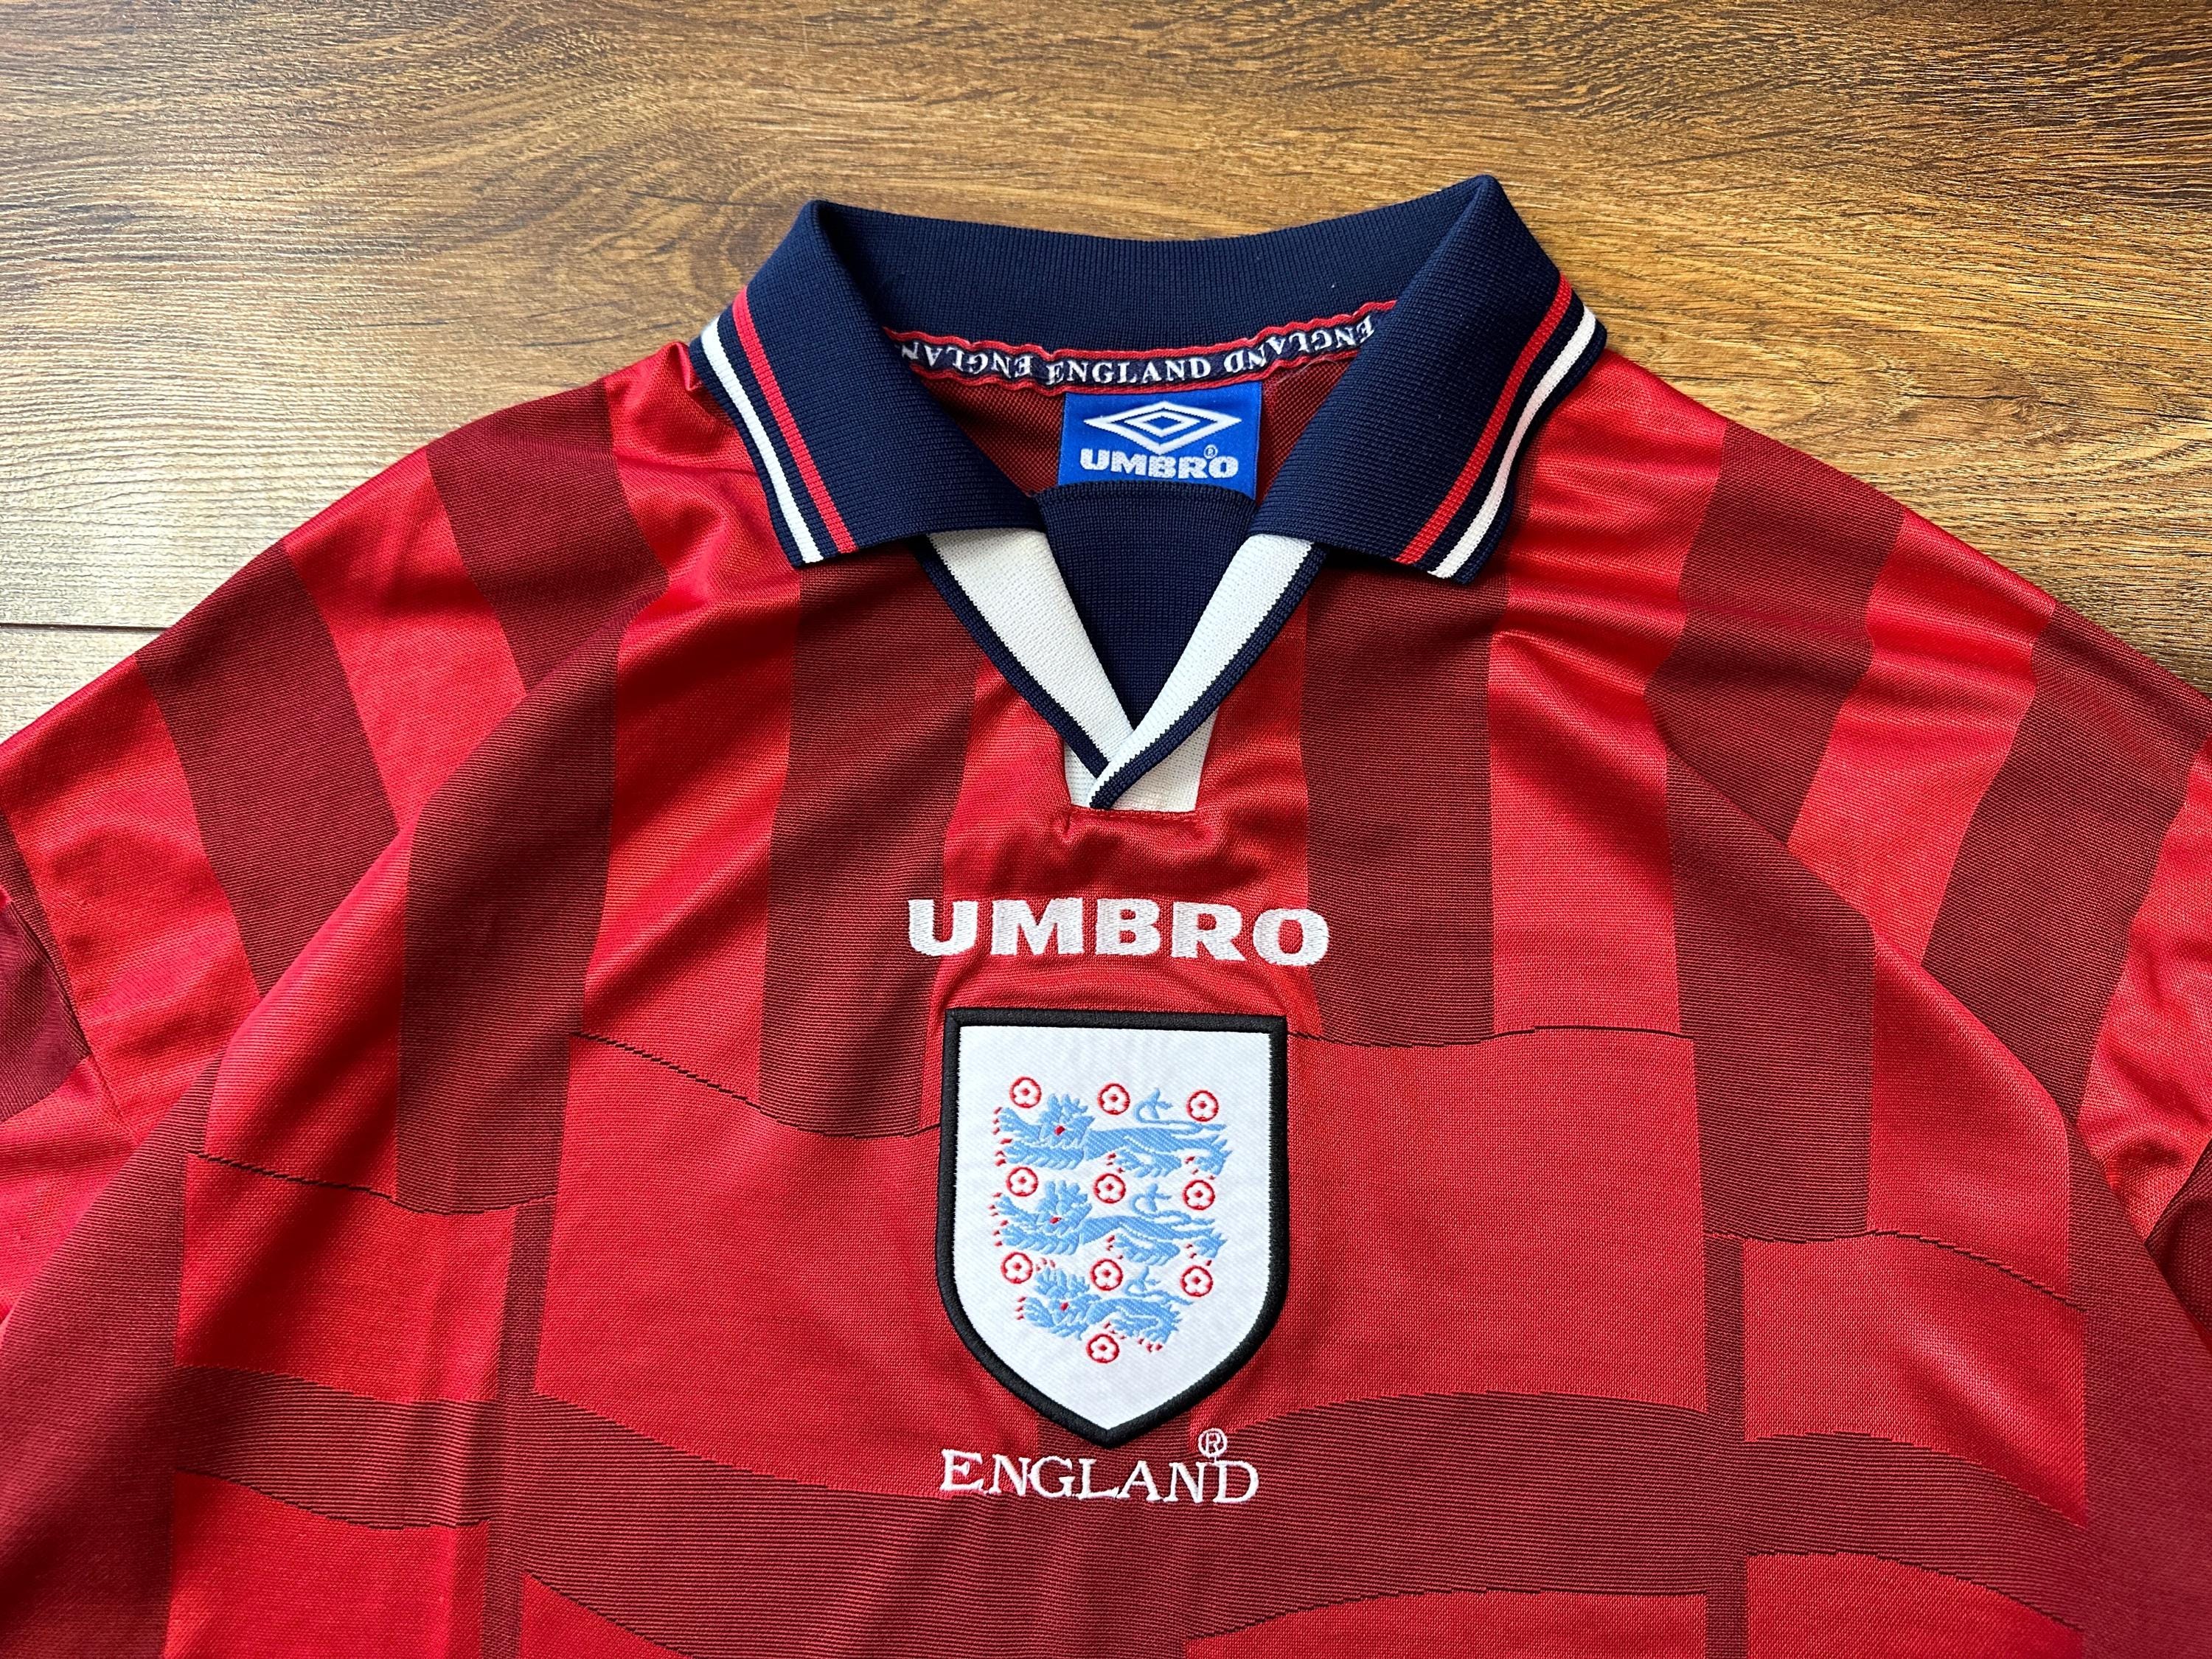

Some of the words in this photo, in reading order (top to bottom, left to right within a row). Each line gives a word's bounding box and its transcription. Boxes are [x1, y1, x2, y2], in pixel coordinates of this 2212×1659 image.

[901, 341, 1034, 378] ENGLAN
[1223, 315, 1375, 373] ENGLAND
[1046, 358, 1211, 385] ENGLAND
[1079, 448, 1239, 479] UMBRO
[907, 897, 1330, 966] UMBRO
[939, 1449, 1259, 1503] ENGLAND
